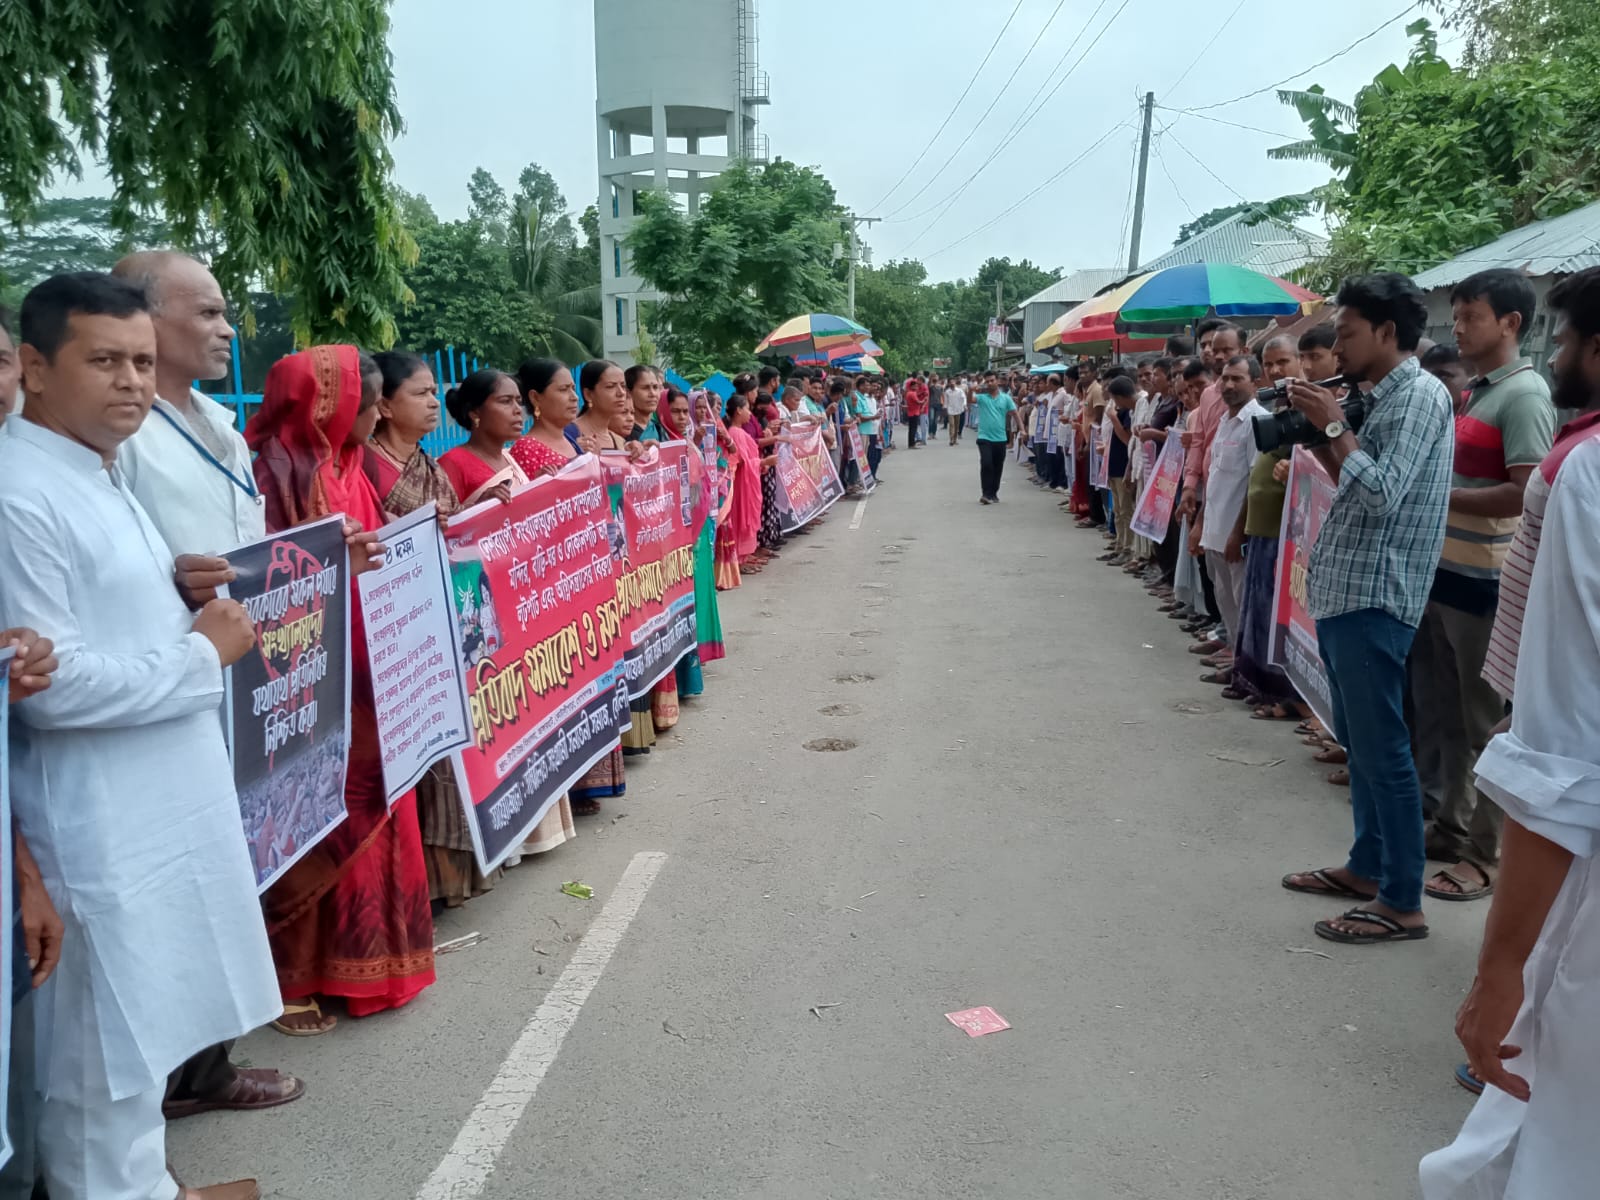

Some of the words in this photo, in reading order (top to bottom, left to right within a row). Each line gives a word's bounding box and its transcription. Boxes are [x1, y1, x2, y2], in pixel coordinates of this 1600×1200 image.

[394, 537, 414, 558] দফা
[478, 518, 517, 561] দেশব্যাপী
[512, 506, 558, 544] সংখ্যালঘুদের
[556, 498, 573, 522] উপর
[558, 543, 564, 561] ও
[564, 520, 597, 558] দোকানপাট
[290, 574, 315, 607] সকল
[516, 589, 540, 632] লুটপাট
[541, 586, 558, 609] এবং
[262, 608, 323, 660] সংখ্যালঘুদের
[252, 673, 289, 716] যথাযথ
[469, 658, 529, 751] প্রতিবাদ
[524, 620, 584, 695] সমাবেশ
[582, 612, 598, 657] ও
[264, 708, 296, 757] নিশ্চিত
[567, 709, 592, 753] সনাতনী
